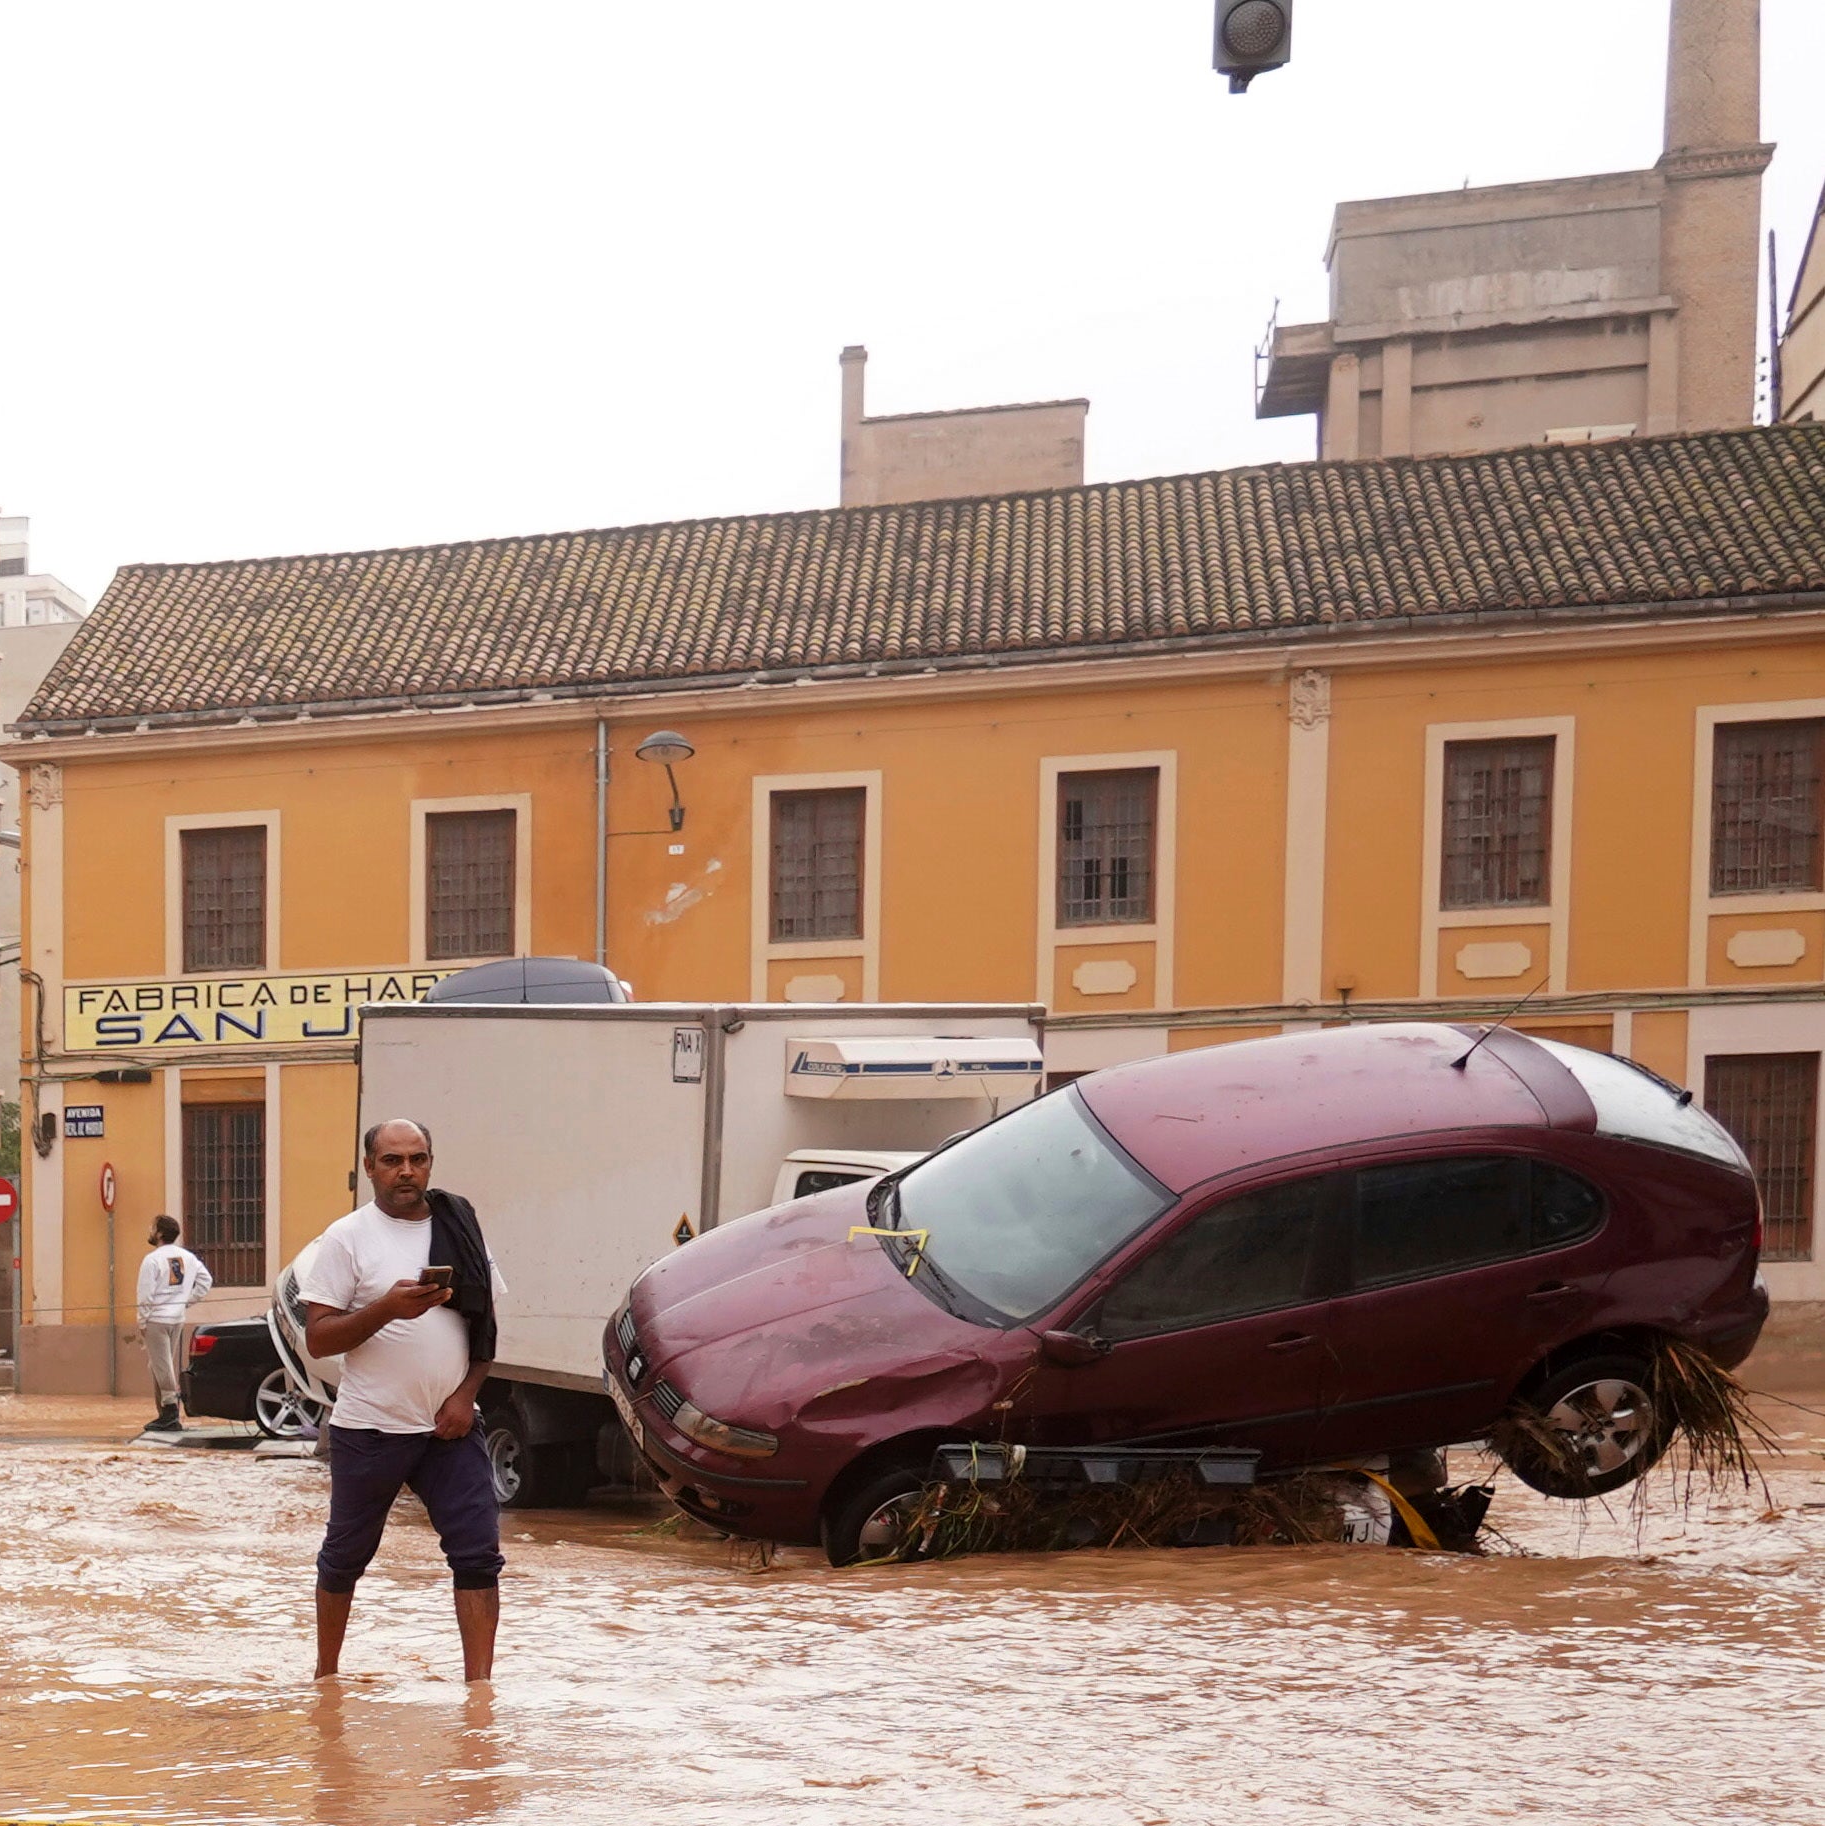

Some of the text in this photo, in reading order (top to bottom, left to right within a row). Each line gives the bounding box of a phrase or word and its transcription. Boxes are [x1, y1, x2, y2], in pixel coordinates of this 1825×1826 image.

[79, 974, 451, 1014] FABRICA DE HAR
[96, 1009, 266, 1046] SAN
